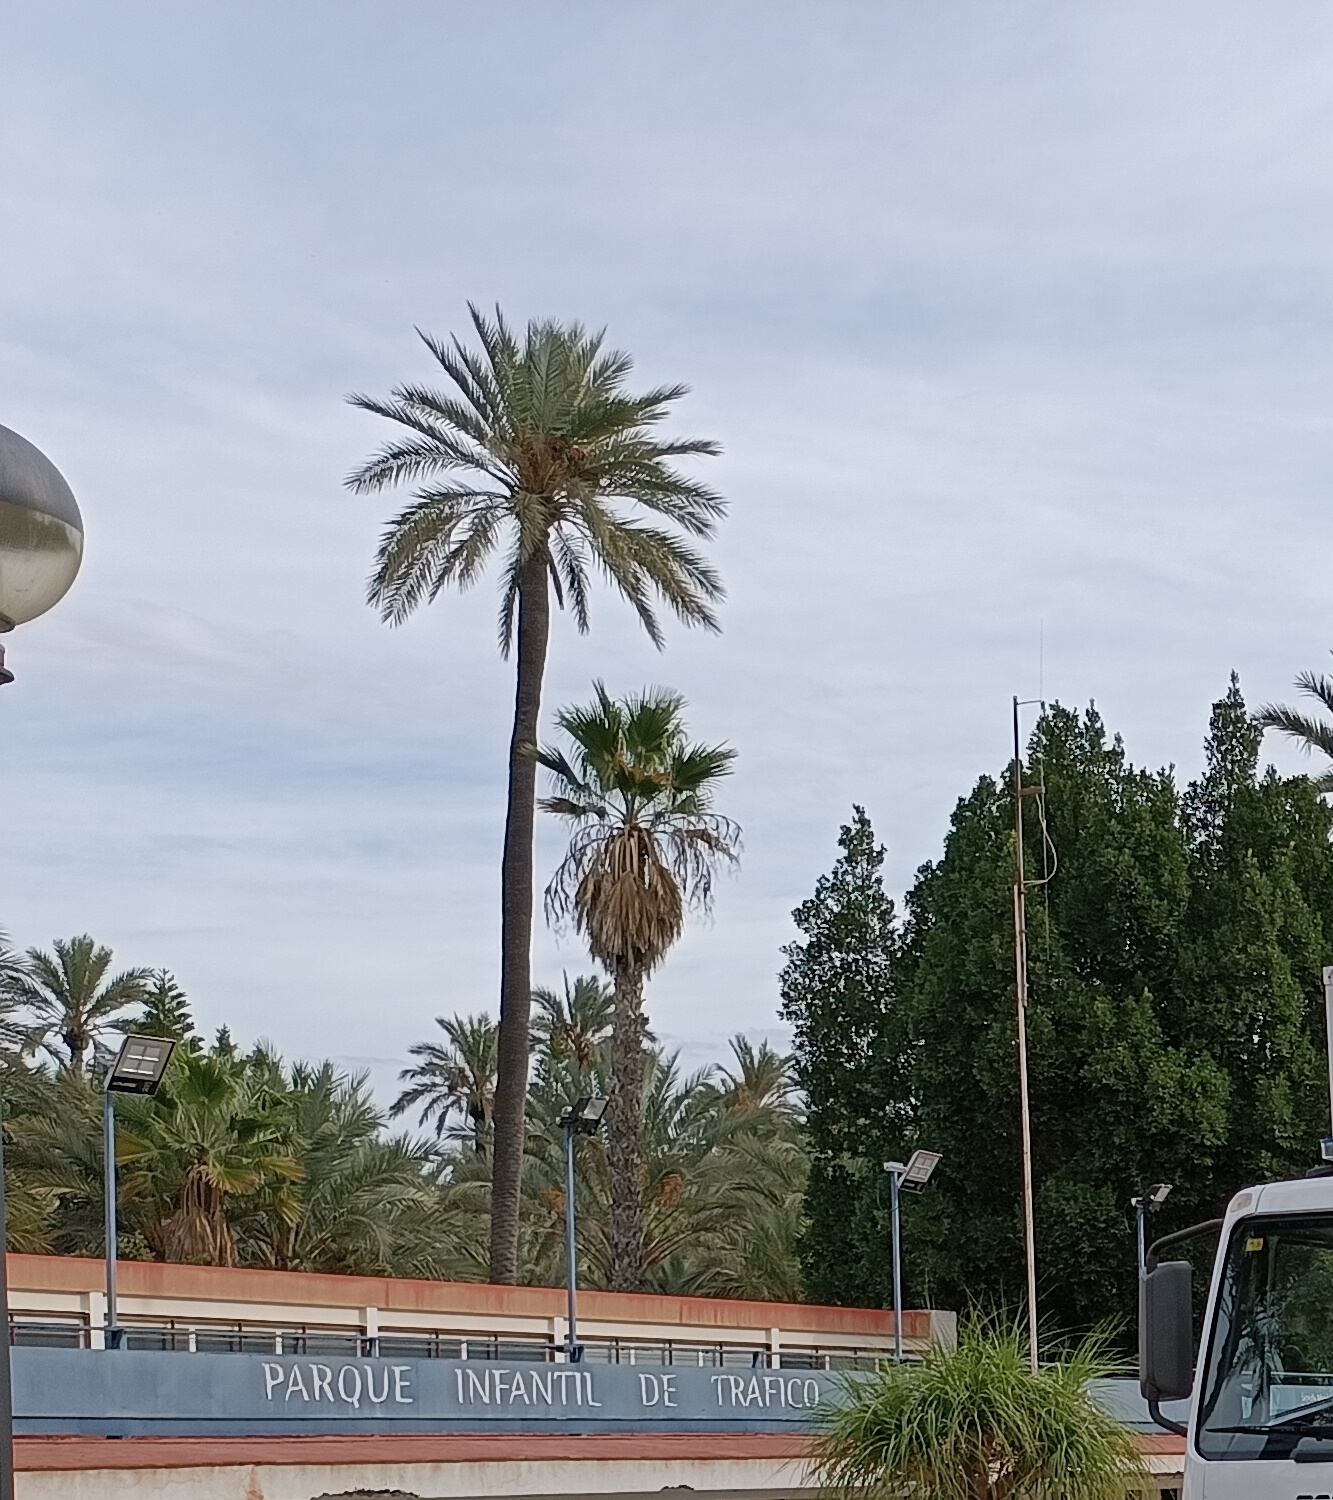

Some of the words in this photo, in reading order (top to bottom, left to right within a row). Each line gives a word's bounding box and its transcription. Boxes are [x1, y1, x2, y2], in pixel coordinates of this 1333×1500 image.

[261, 1362, 414, 1409] PARQUE
[454, 1367, 603, 1408] INFANTIL
[638, 1373, 678, 1407] DE
[710, 1374, 820, 1408] TRAFICO
